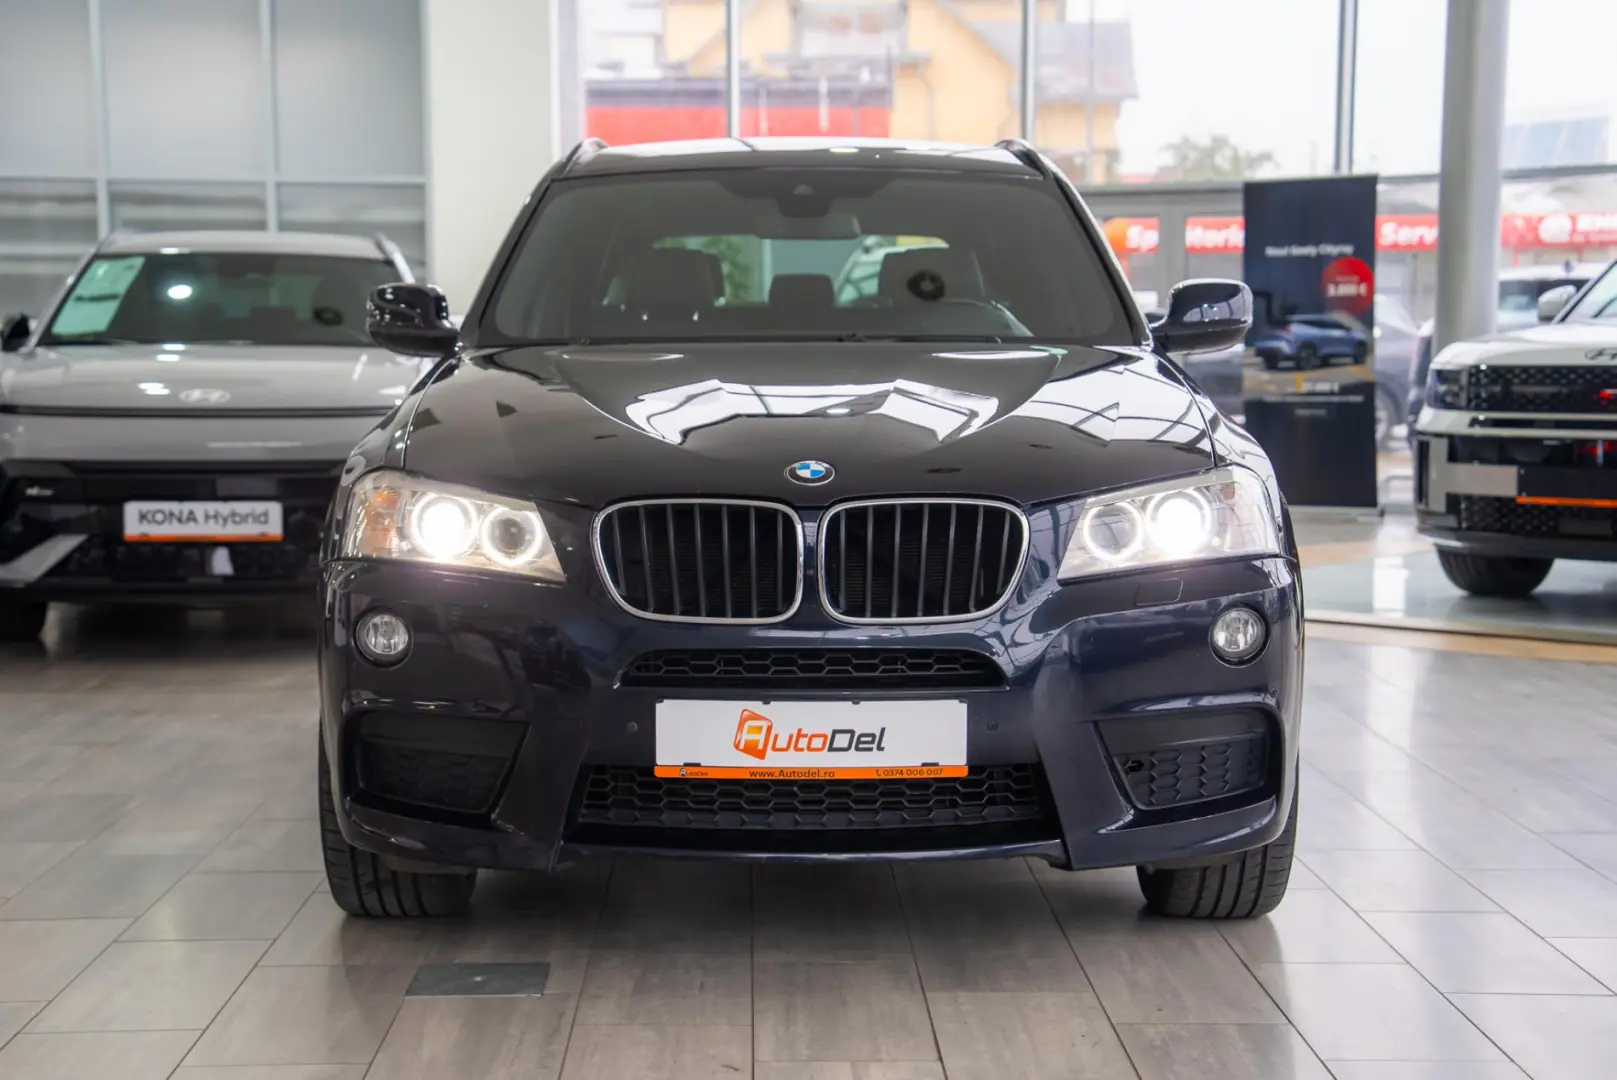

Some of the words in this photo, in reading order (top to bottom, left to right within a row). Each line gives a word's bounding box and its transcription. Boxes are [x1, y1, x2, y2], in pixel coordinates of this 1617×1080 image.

[138, 509, 199, 525] KONA
[204, 509, 270, 528] Hybrid
[736, 713, 886, 756] AutoDel
[749, 769, 835, 779] www.Autodel.ro
[883, 768, 904, 777] 0374
[906, 768, 925, 777] 006
[926, 768, 944, 777] 007
